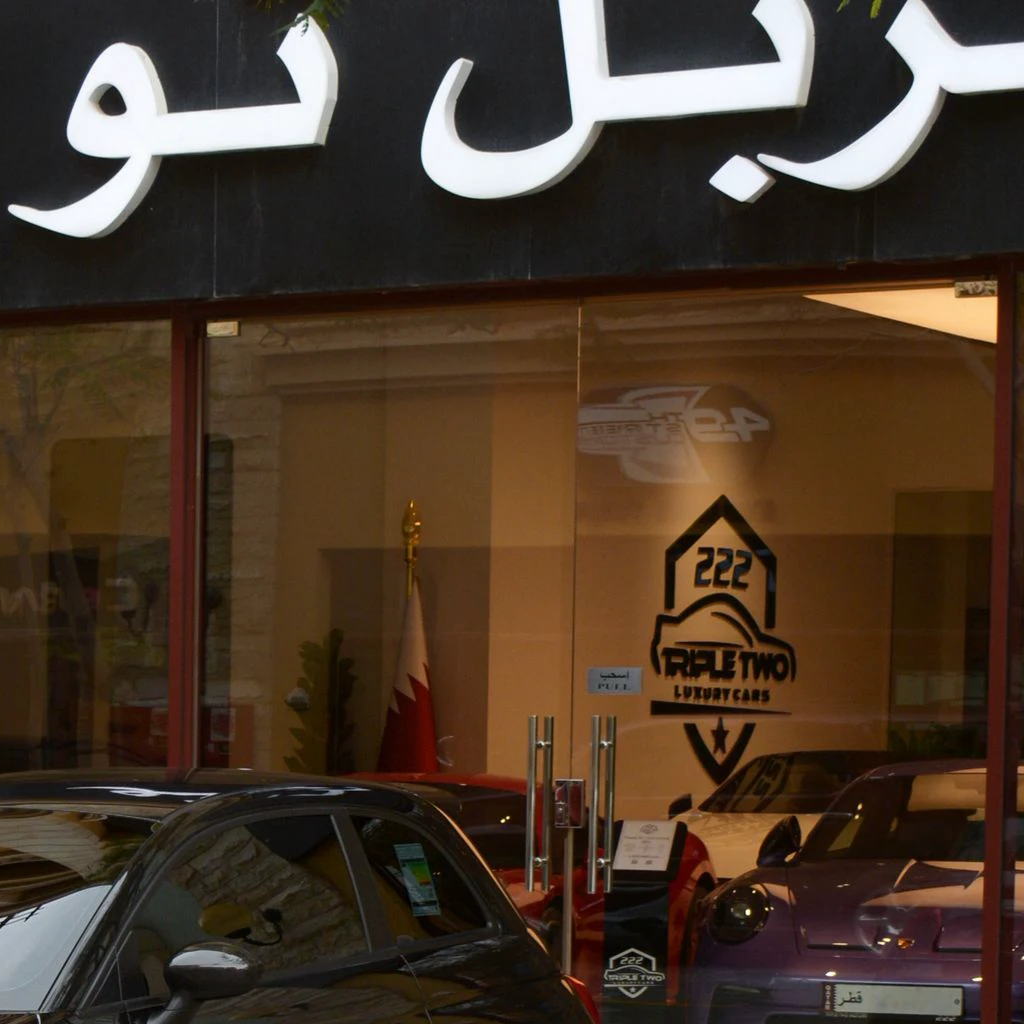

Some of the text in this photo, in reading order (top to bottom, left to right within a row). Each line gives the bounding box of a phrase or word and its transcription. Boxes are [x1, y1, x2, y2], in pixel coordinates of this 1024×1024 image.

[420, 0, 1024, 203] ربل
[693, 546, 753, 591] 222
[661, 647, 789, 683] TRIPLE TWO
[673, 684, 772, 703] LUXURY CARS
[619, 956, 644, 965] 222
[639, 974, 662, 983] TWO
